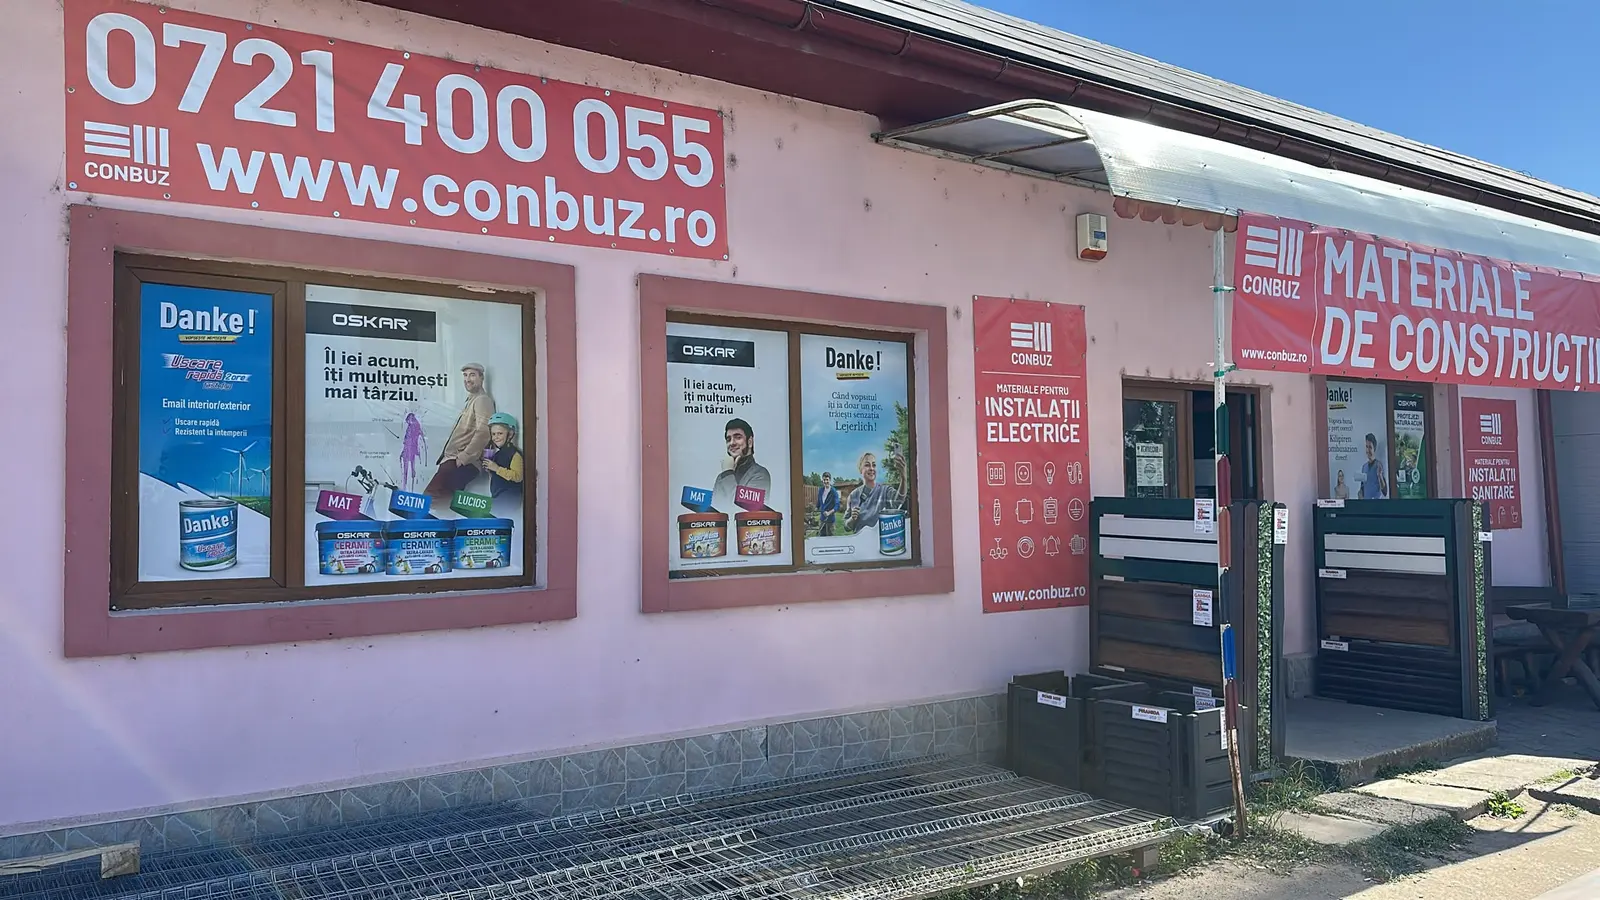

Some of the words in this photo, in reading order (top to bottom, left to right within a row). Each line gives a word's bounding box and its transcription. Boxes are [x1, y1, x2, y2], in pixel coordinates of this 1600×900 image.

[86, 12, 335, 133] 0721
[367, 62, 548, 163] 400
[573, 98, 714, 187] 055
[84, 161, 170, 187] CONBUZ
[196, 142, 716, 247] www.conbuz.ro
[1323, 236, 1534, 321] MATERIALE
[1242, 274, 1300, 299] CONBUZ
[332, 313, 409, 331] OSKAR
[1321, 306, 1378, 369] DE
[682, 344, 735, 359] OSKAR
[826, 347, 881, 371] Danke!
[1011, 352, 1053, 366] CONBUZ
[1241, 348, 1308, 363] www.conbuz.ro
[171, 354, 223, 369] Uscare
[341, 351, 362, 366] iei
[367, 355, 420, 370] acum,
[324, 367, 343, 383] îți
[349, 370, 448, 389] mulțumești
[692, 379, 705, 390] iei
[707, 382, 736, 393] acum,
[996, 384, 1039, 394] MATERIALE
[1040, 386, 1069, 395] PENTRU
[325, 386, 358, 400] mai
[363, 386, 418, 402] târziu.
[684, 391, 695, 404] îți
[697, 392, 752, 406] mulțumești
[832, 391, 850, 400] Când
[851, 393, 877, 402] vopsitul
[1327, 387, 1353, 402] anke!
[162, 398, 186, 409] Email
[188, 400, 251, 411] interior/exterior
[684, 404, 703, 414] mai
[705, 404, 734, 415] târziu
[836, 401, 843, 409] ia
[844, 401, 859, 409] doar
[871, 403, 883, 411] pic,
[985, 396, 1080, 422] INSTALAȚII
[175, 418, 198, 426] Uscare
[835, 421, 877, 433] Lejerlich!
[175, 428, 206, 436] Rezistent
[214, 429, 248, 438] intemperii
[987, 422, 1080, 443] ELECTRICE
[1481, 436, 1502, 445] CONBUZ
[1469, 467, 1516, 484] INSTALAȚII
[690, 490, 706, 503] MAT
[739, 488, 760, 503] SATIN
[1472, 485, 1515, 500] SANITARE
[328, 495, 353, 510] MAT
[397, 495, 425, 509] SATIN
[457, 494, 487, 509] LUCIOS
[184, 510, 234, 533] Danke!
[881, 516, 904, 531] Danke!
[403, 531, 437, 539] OSKAR
[464, 538, 498, 546] CERAMIC
[334, 541, 372, 550] CERAMIC
[401, 540, 440, 550] CERAMIC
[992, 585, 1086, 603] www.conbuz.ro
